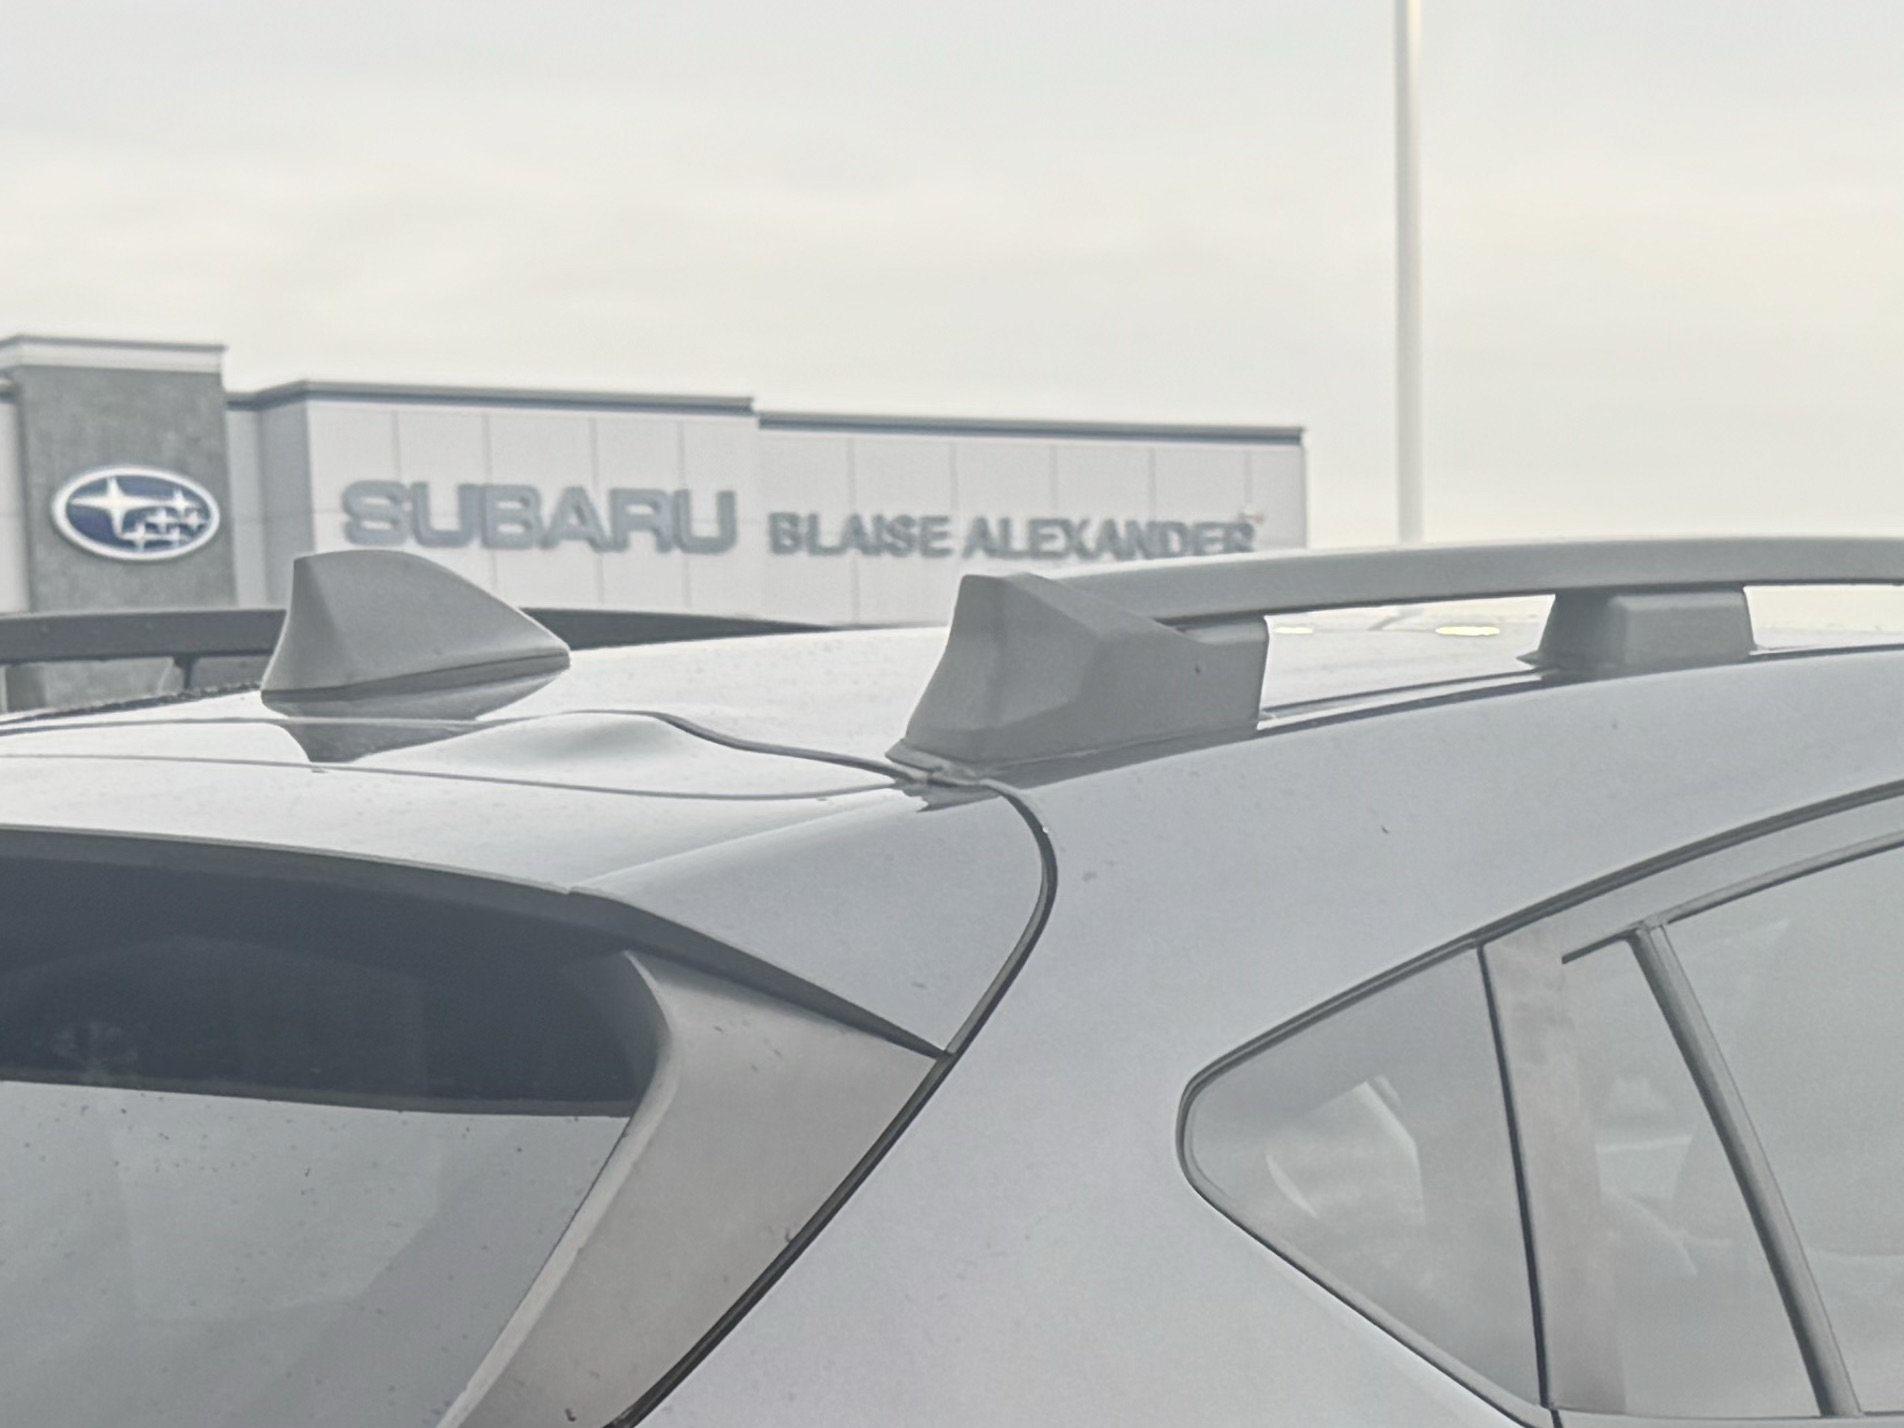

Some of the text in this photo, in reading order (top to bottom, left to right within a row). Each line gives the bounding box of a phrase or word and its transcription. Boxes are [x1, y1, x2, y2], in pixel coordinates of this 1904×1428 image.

[342, 480, 737, 554] SUBARU
[768, 511, 1256, 560] BLAISE ALEXANDER
